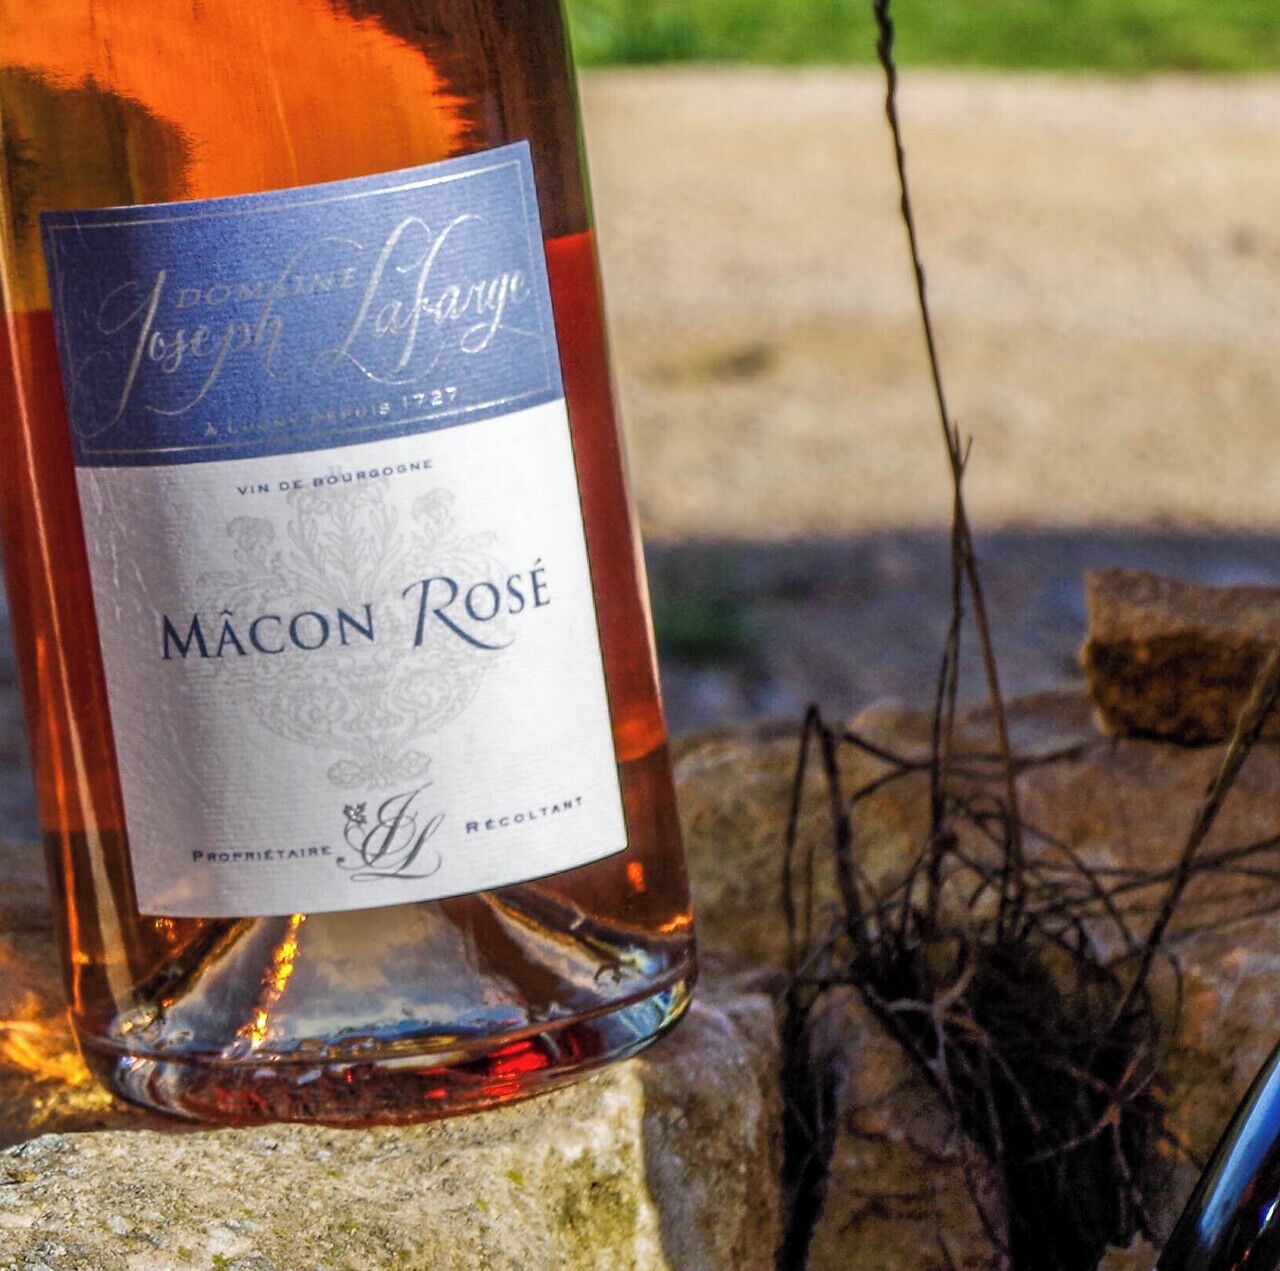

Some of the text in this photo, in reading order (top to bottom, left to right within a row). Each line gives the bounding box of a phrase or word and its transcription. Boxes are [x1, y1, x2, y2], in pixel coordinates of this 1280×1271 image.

[177, 266, 359, 310] DOMAINE
[312, 213, 538, 385] Lafarge
[402, 386, 458, 414] 1727
[237, 459, 434, 497] VIN DE BOURGOGNE
[160, 557, 552, 661] MÂCON ROSÉ
[191, 844, 333, 864] PROPRIÉTAIRE
[464, 795, 584, 836] RÉCOLTANT
